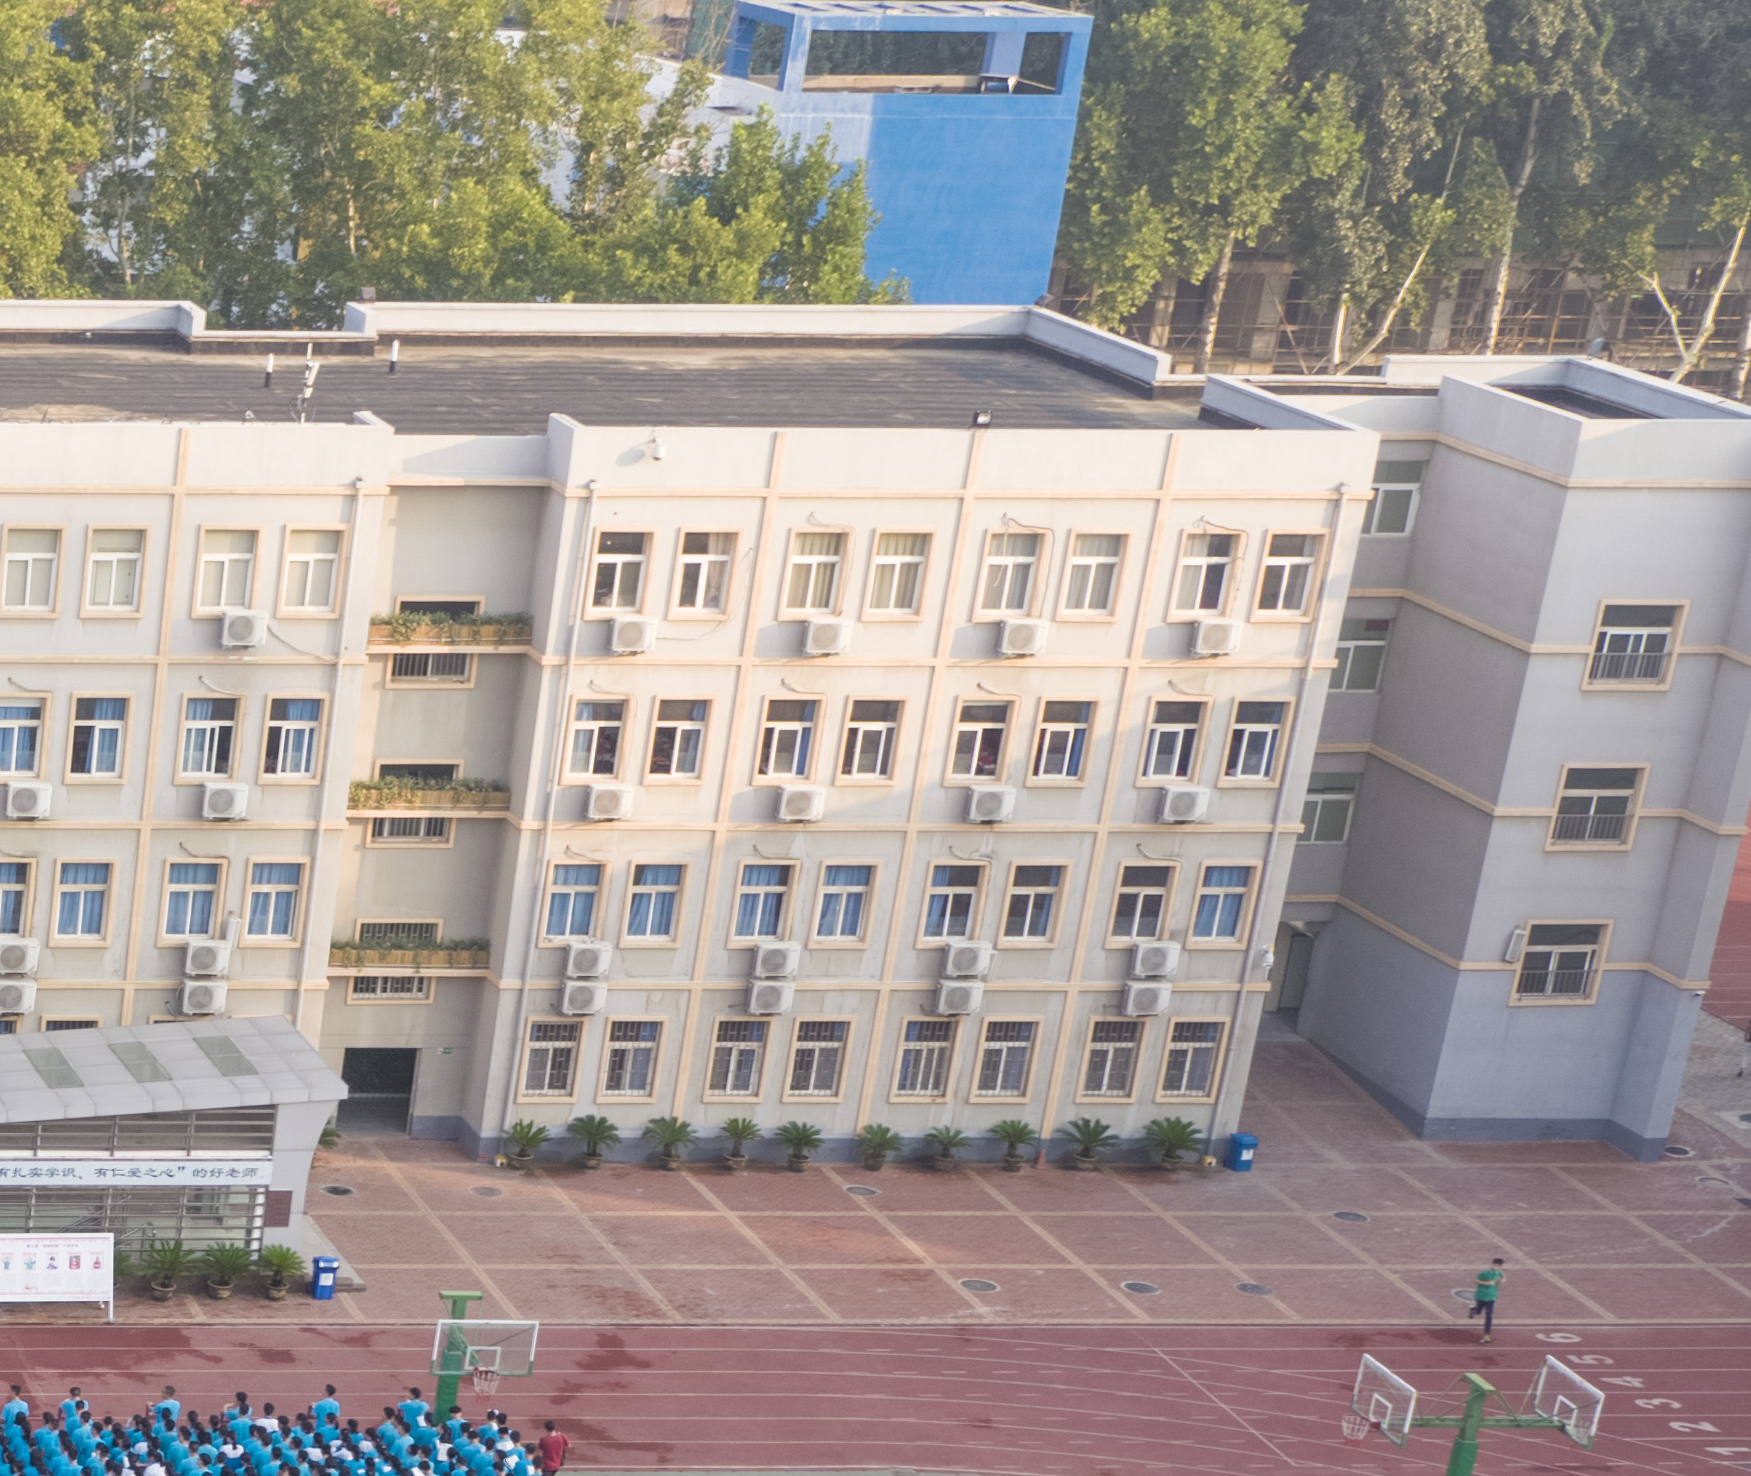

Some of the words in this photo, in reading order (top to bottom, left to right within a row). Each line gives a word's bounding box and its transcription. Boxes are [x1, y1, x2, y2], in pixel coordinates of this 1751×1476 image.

[1535, 1332, 1582, 1343] 6
[1565, 1354, 1614, 1364] 5
[1599, 1376, 1644, 1388] 4
[1634, 1398, 1683, 1409] 3
[1668, 1421, 1721, 1433] 2
[1704, 1447, 1751, 1455] 1
